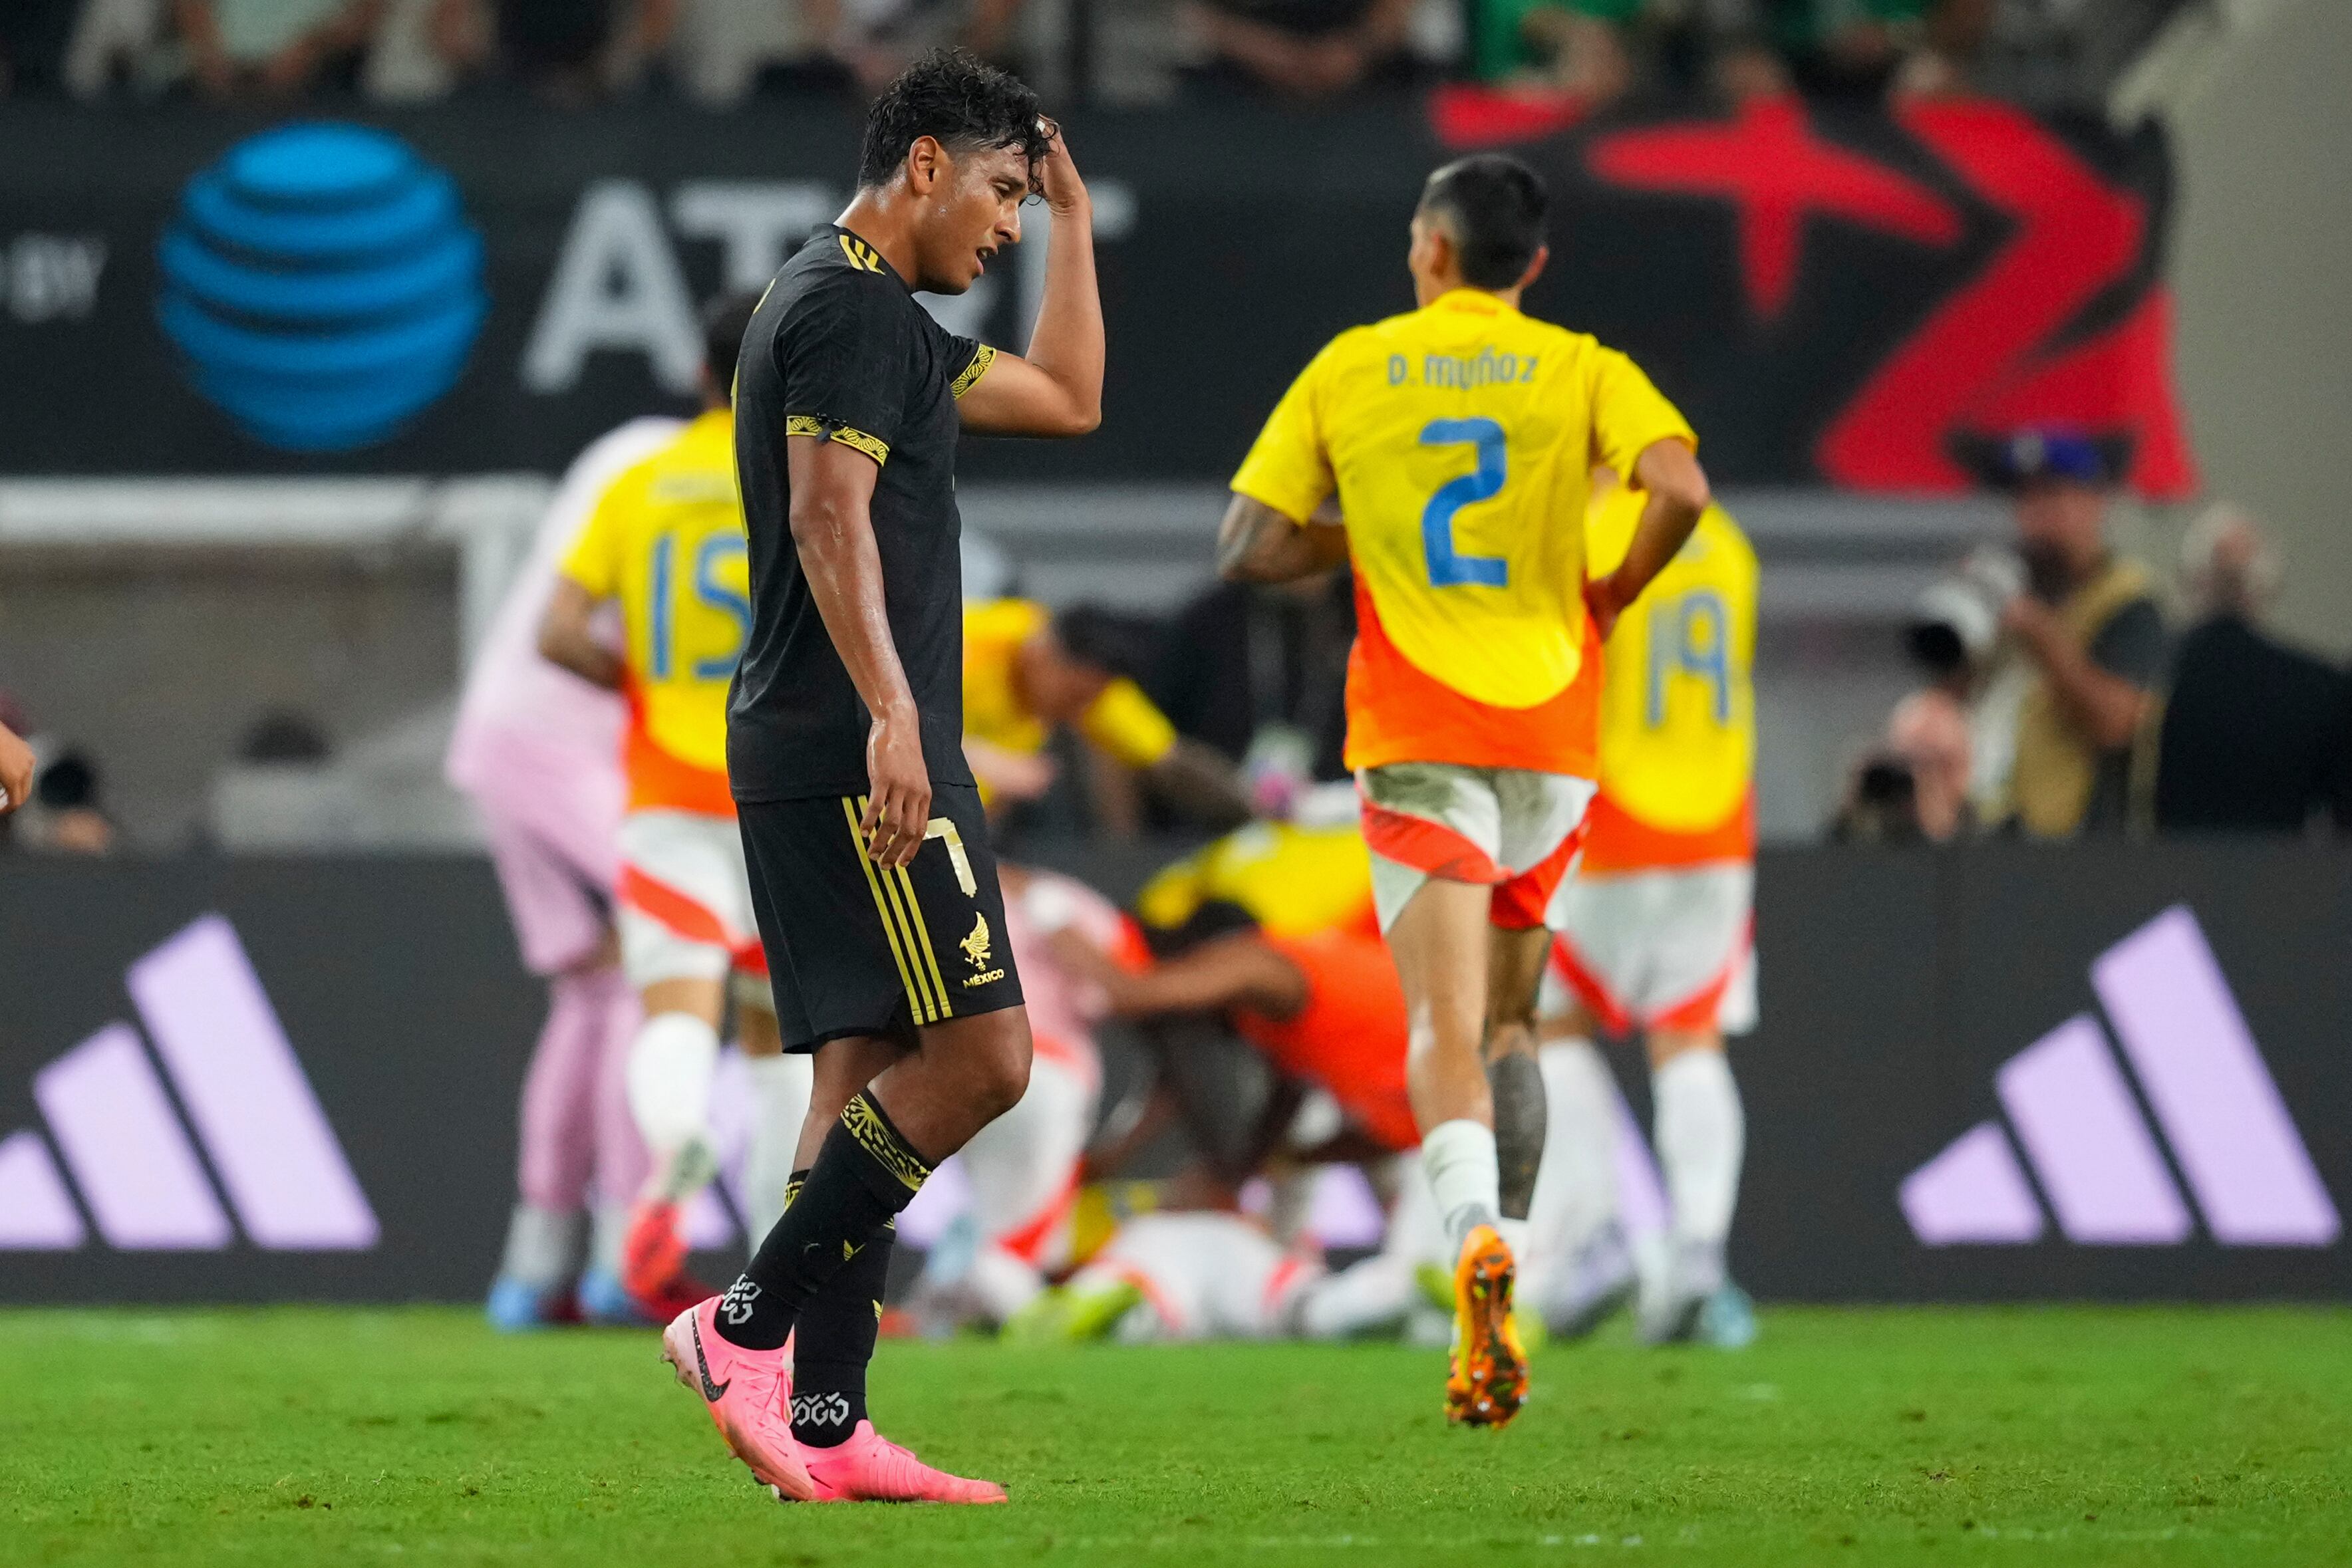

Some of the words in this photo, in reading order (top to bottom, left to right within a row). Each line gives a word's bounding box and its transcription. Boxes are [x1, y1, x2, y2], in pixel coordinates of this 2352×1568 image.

[1388, 353, 1417, 386] D.
[1418, 416, 1508, 587] 2
[647, 529, 752, 680] 15
[1646, 590, 1733, 727] 19
[923, 817, 978, 898] 7
[962, 968, 1004, 989] MÉXICO
